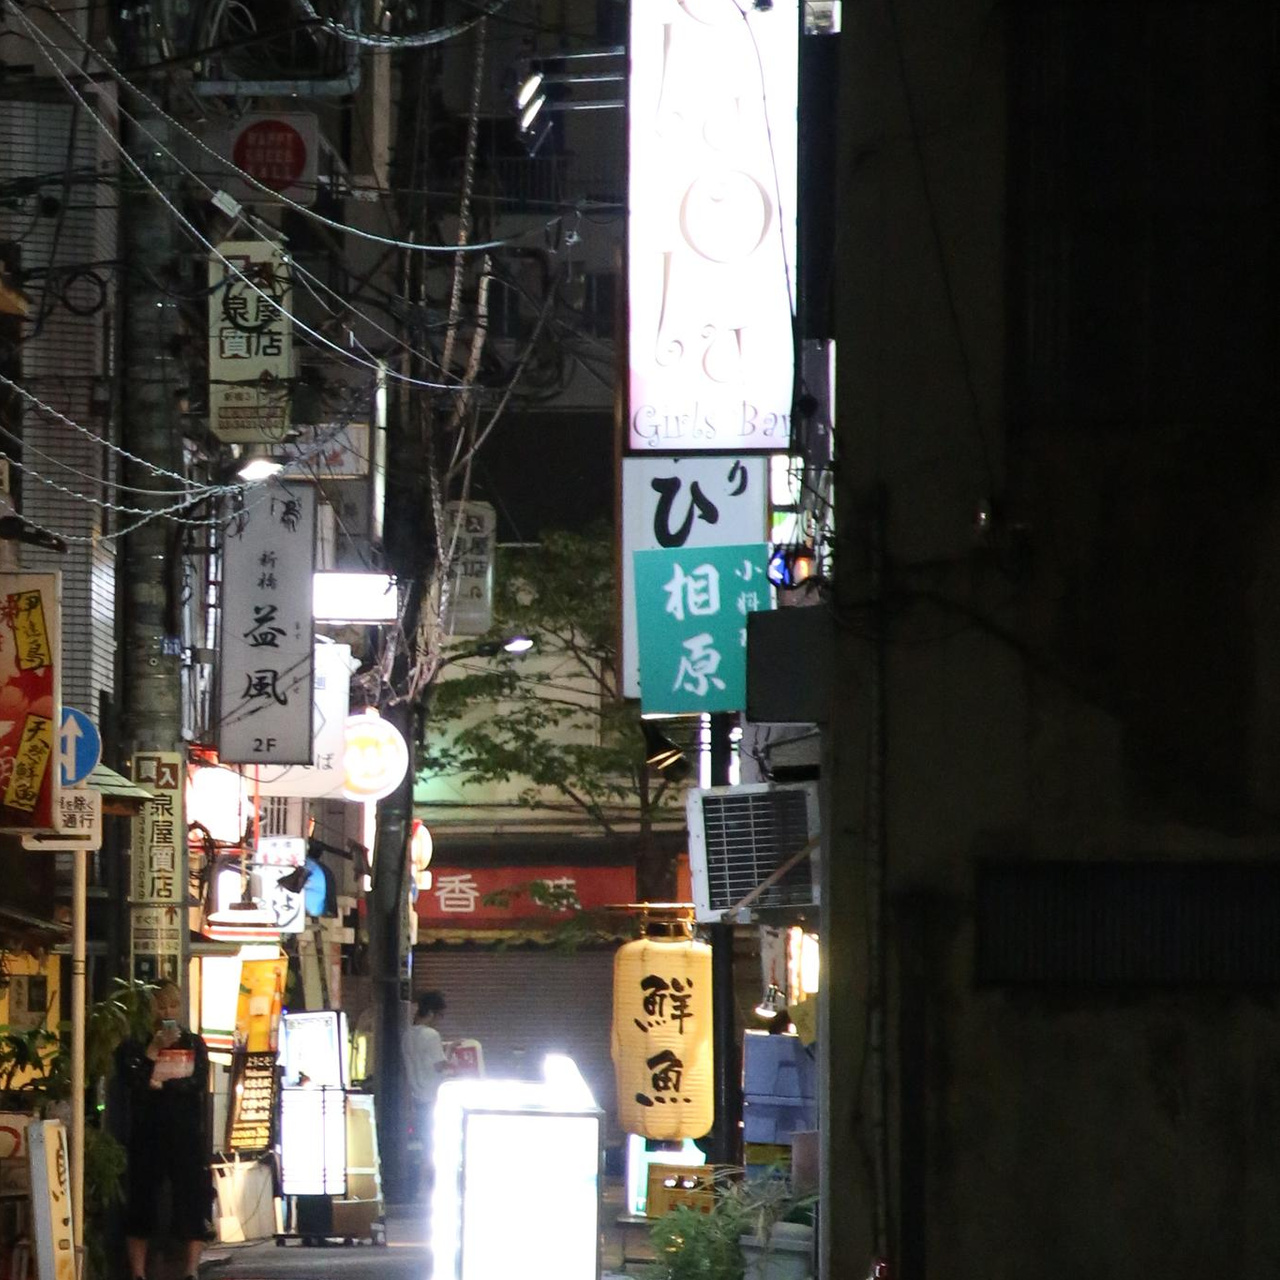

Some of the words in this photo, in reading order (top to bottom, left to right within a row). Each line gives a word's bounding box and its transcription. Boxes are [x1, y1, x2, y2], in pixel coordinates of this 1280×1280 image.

[632, 402, 717, 449] Girls
[243, 604, 288, 707] 益風
[662, 562, 727, 698] 相原
[253, 738, 278, 753] 2F
[150, 793, 175, 899] 泉屋質店
[633, 974, 694, 1108] 鮮魚
